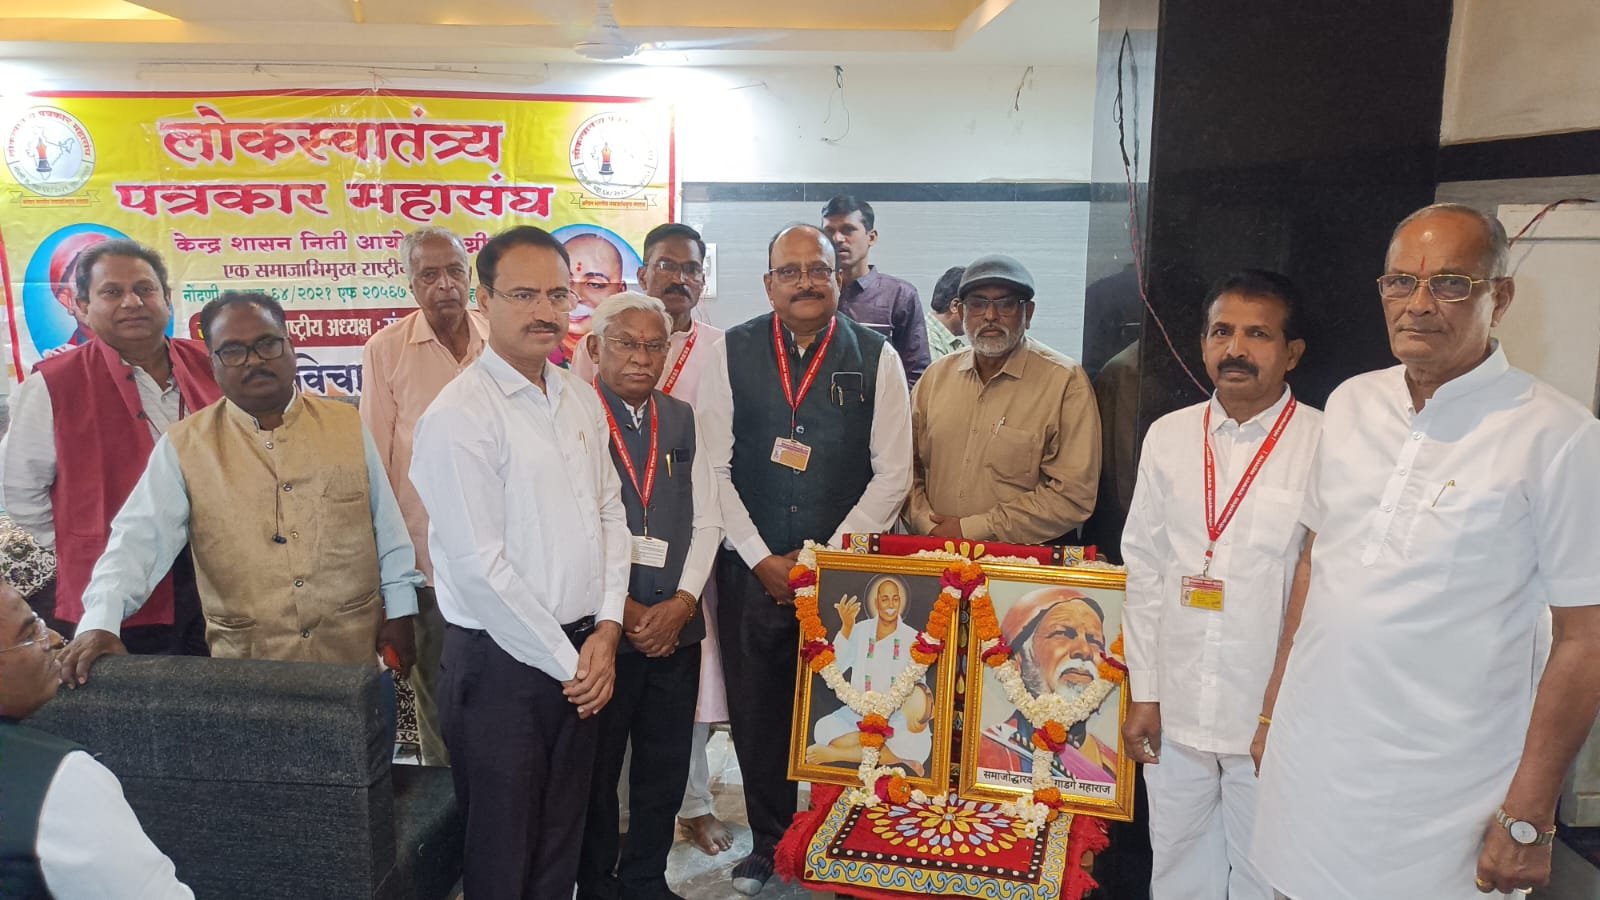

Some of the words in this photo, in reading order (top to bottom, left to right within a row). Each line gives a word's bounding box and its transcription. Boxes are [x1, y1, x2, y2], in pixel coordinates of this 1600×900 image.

[159, 105, 503, 163] लोकस्वातंत्र्य
[116, 184, 328, 216] पत्रकार
[346, 173, 554, 222] महासंघ
[174, 232, 222, 254] केन्द्र
[231, 237, 292, 252] शासन
[300, 230, 348, 251] निती
[223, 264, 250, 279] एक
[337, 287, 357, 302] एफ
[326, 318, 372, 337] अध्यक्ष
[665, 367, 681, 389] PRESS
[1079, 783, 1111, 795] महाराज
